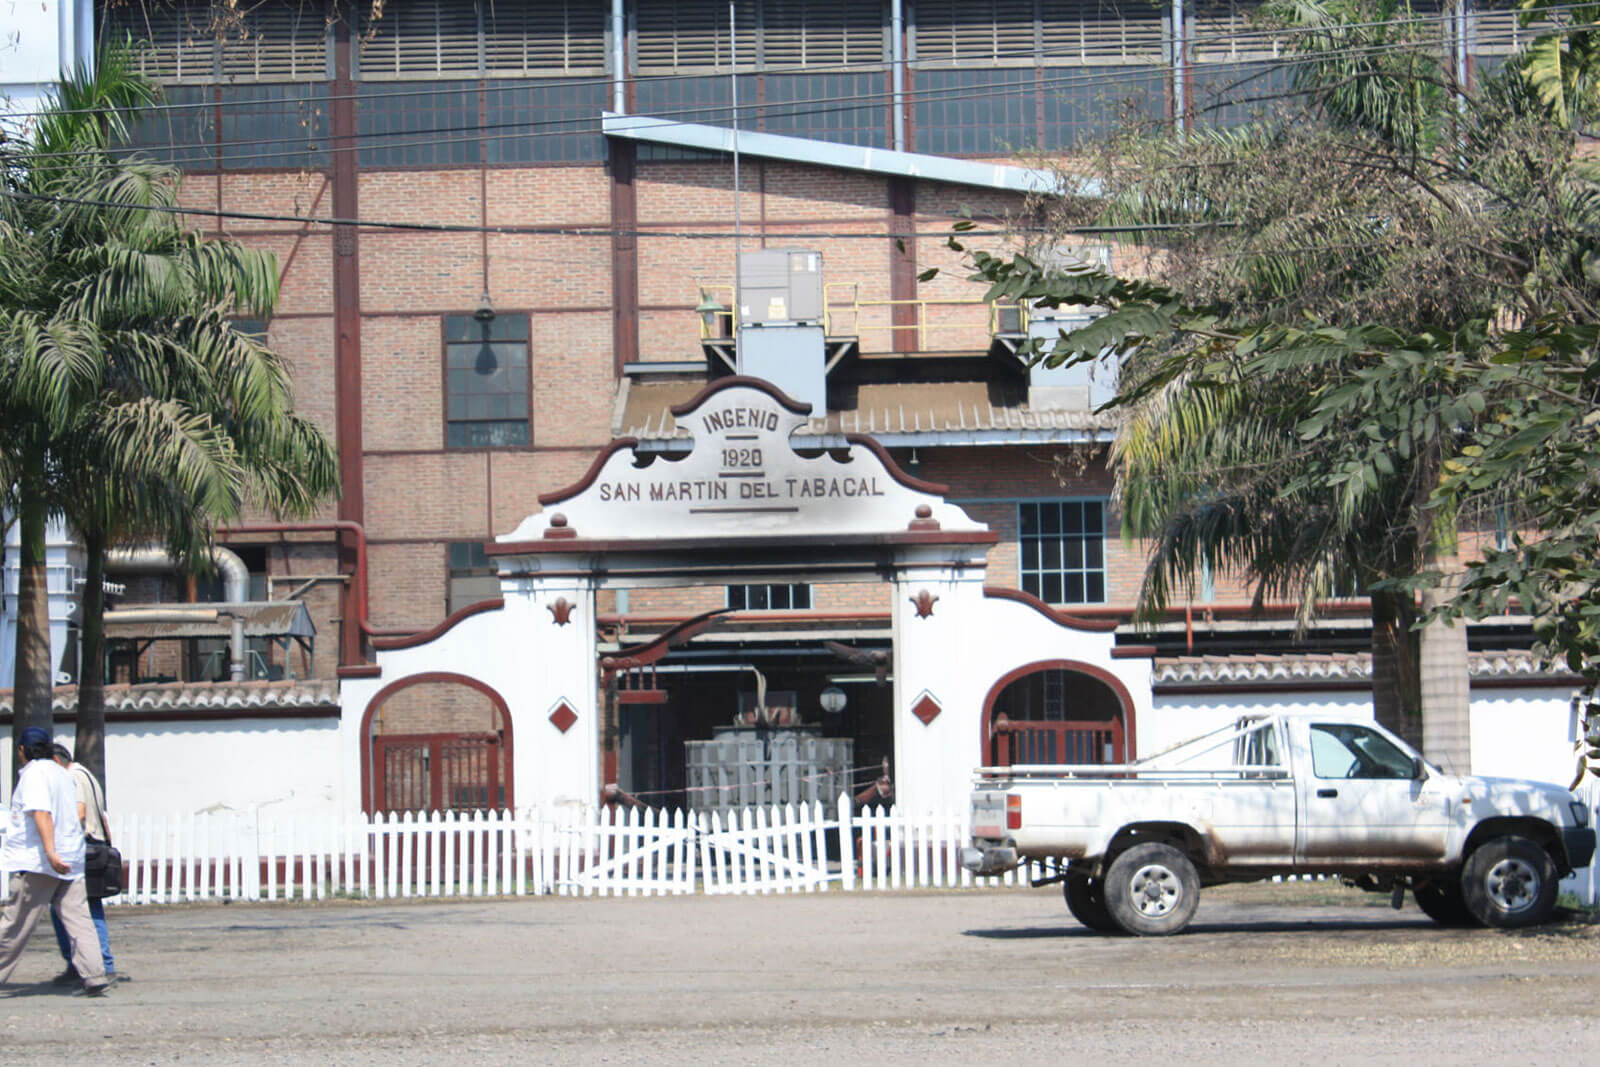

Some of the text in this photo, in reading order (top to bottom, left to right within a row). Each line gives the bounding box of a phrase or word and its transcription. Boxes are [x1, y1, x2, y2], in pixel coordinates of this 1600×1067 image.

[702, 407, 779, 435] INGENIO
[721, 448, 763, 467] 1920
[600, 476, 886, 502] SAN MARTIN DEL TABACAL
